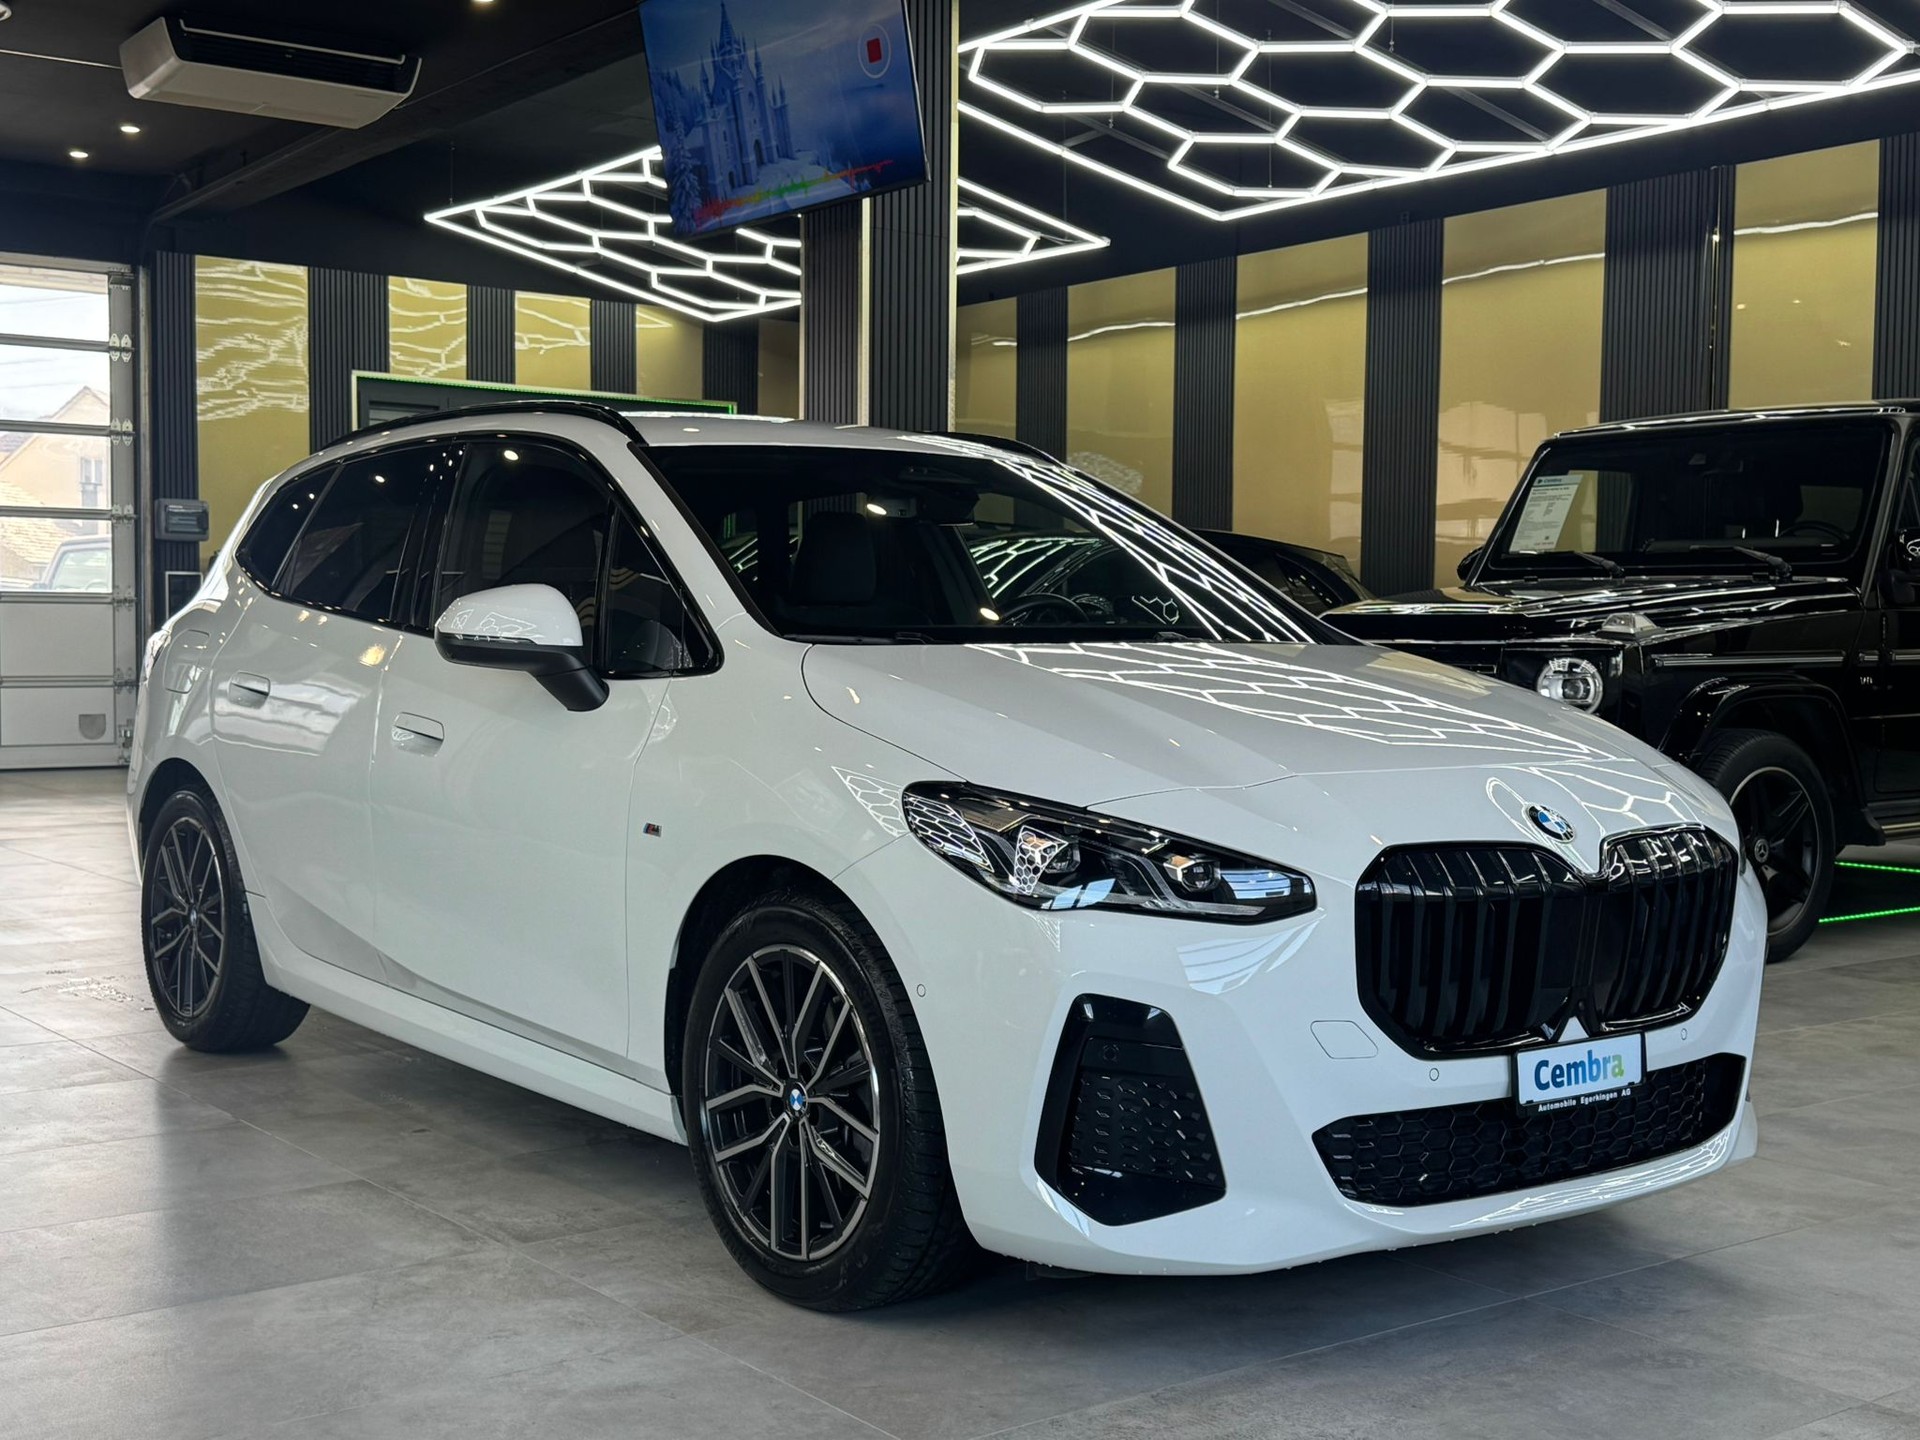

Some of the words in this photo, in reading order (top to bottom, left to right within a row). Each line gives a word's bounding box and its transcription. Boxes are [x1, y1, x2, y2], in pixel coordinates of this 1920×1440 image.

[1534, 1049, 1625, 1091] Cembra
[1538, 1099, 1577, 1112] Automobile
[1580, 1092, 1618, 1104] Egerkingen
[1621, 1088, 1631, 1097] AG
